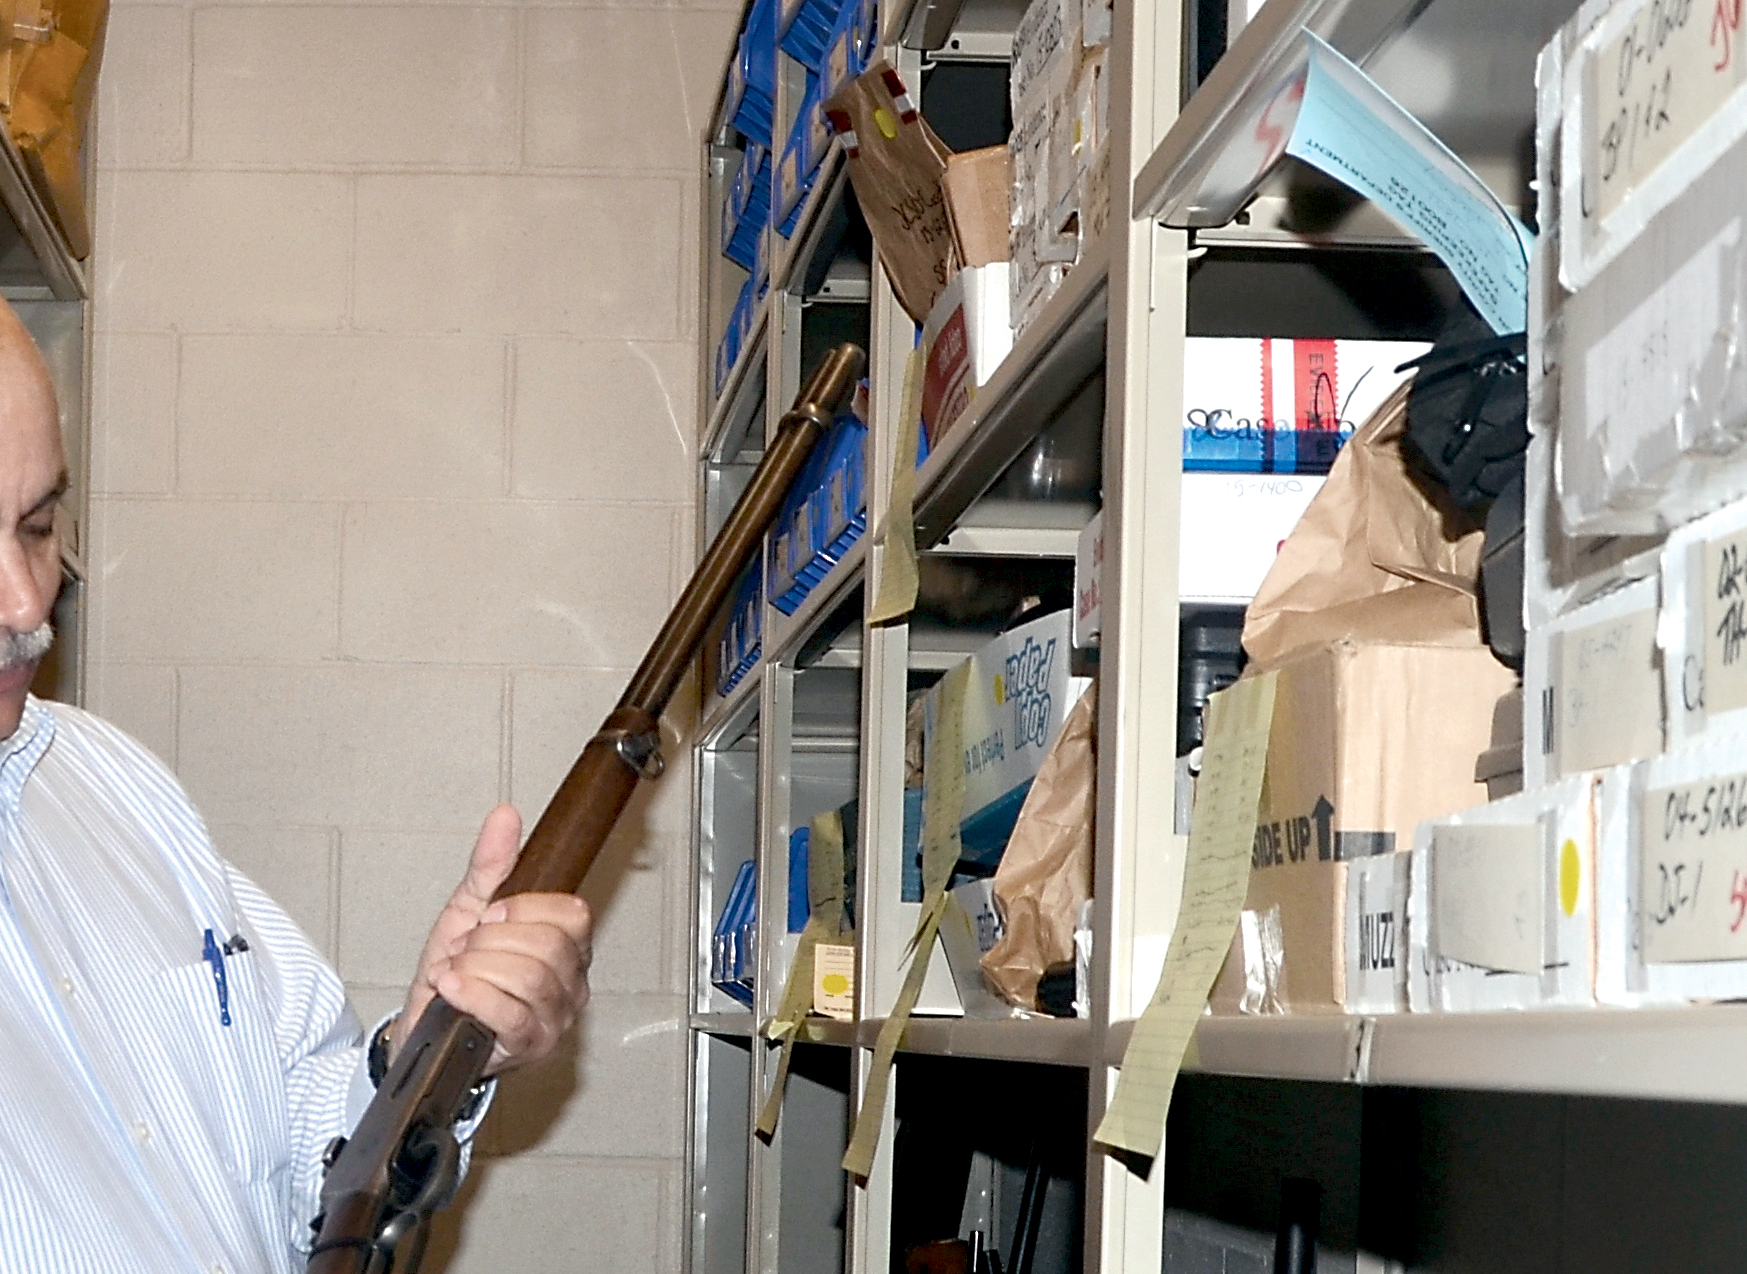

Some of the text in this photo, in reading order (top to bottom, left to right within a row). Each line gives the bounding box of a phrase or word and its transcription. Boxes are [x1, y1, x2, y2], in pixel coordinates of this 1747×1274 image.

[1305, 136, 1393, 204] DEPARTMENT
[1386, 184, 1413, 209] TAG
[1480, 265, 1500, 294] TAG
[1005, 636, 1056, 702] Paper
[1251, 815, 1312, 870] SIDE UP
